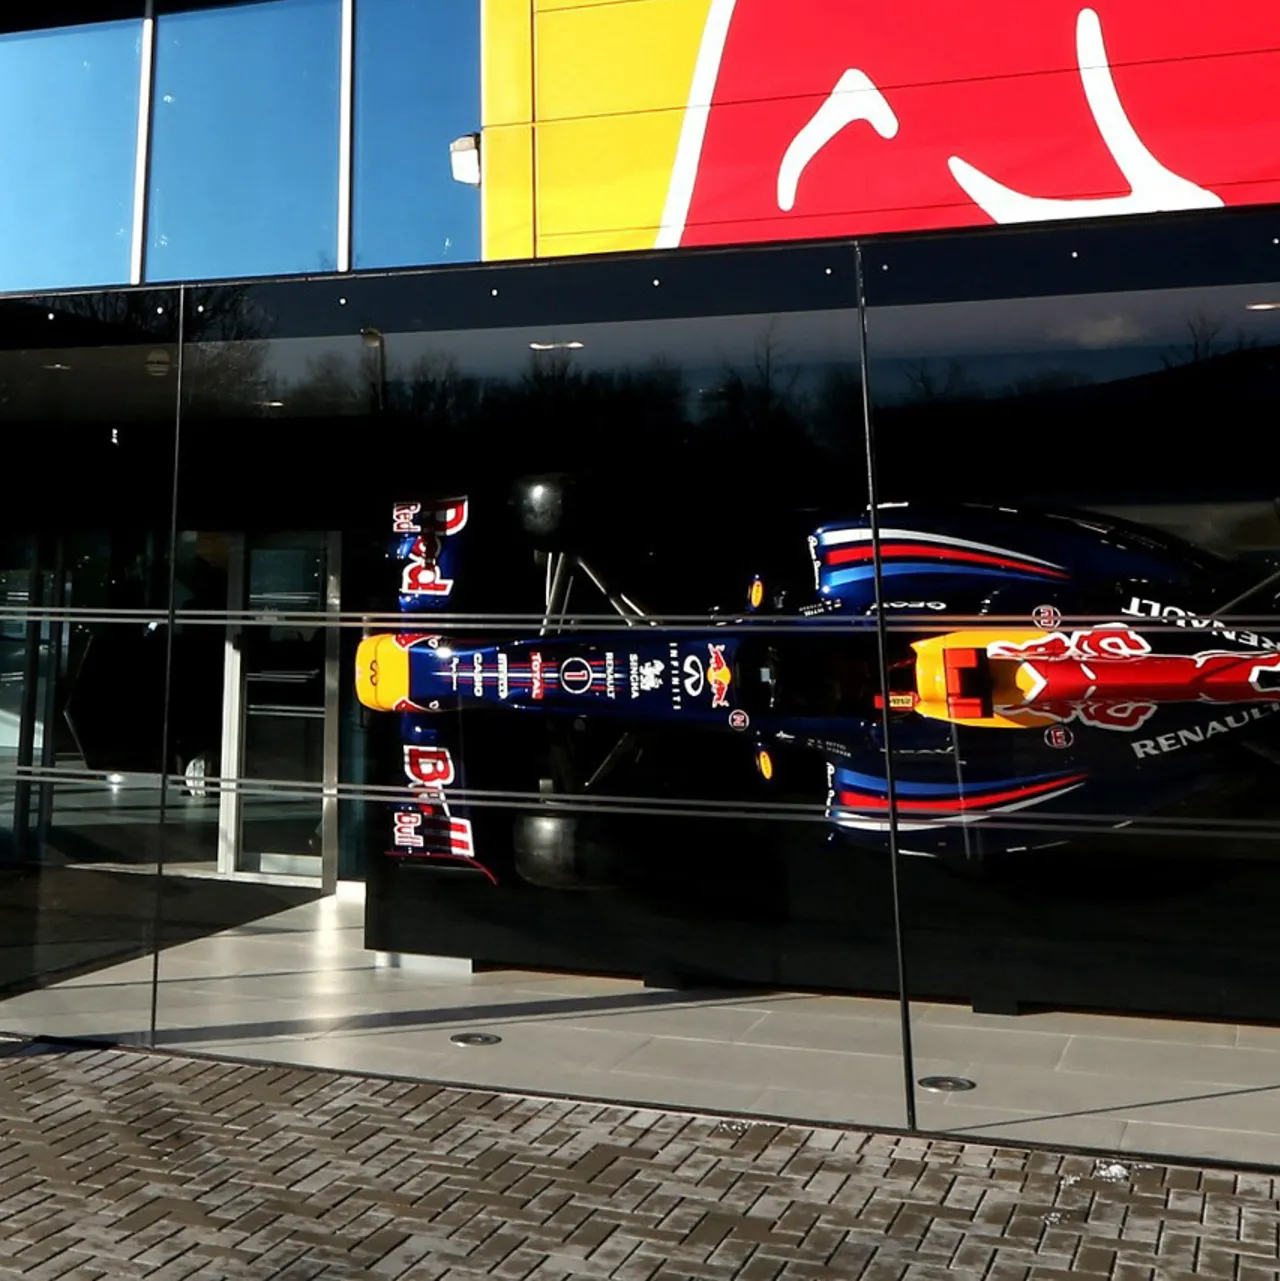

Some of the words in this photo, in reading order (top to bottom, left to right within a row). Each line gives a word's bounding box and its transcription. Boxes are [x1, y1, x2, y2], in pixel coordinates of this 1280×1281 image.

[393, 502, 421, 532] Red
[531, 652, 543, 699] TOTAL
[564, 670, 588, 681] 1
[669, 643, 681, 710] INFINITI
[394, 812, 424, 847] Bull
